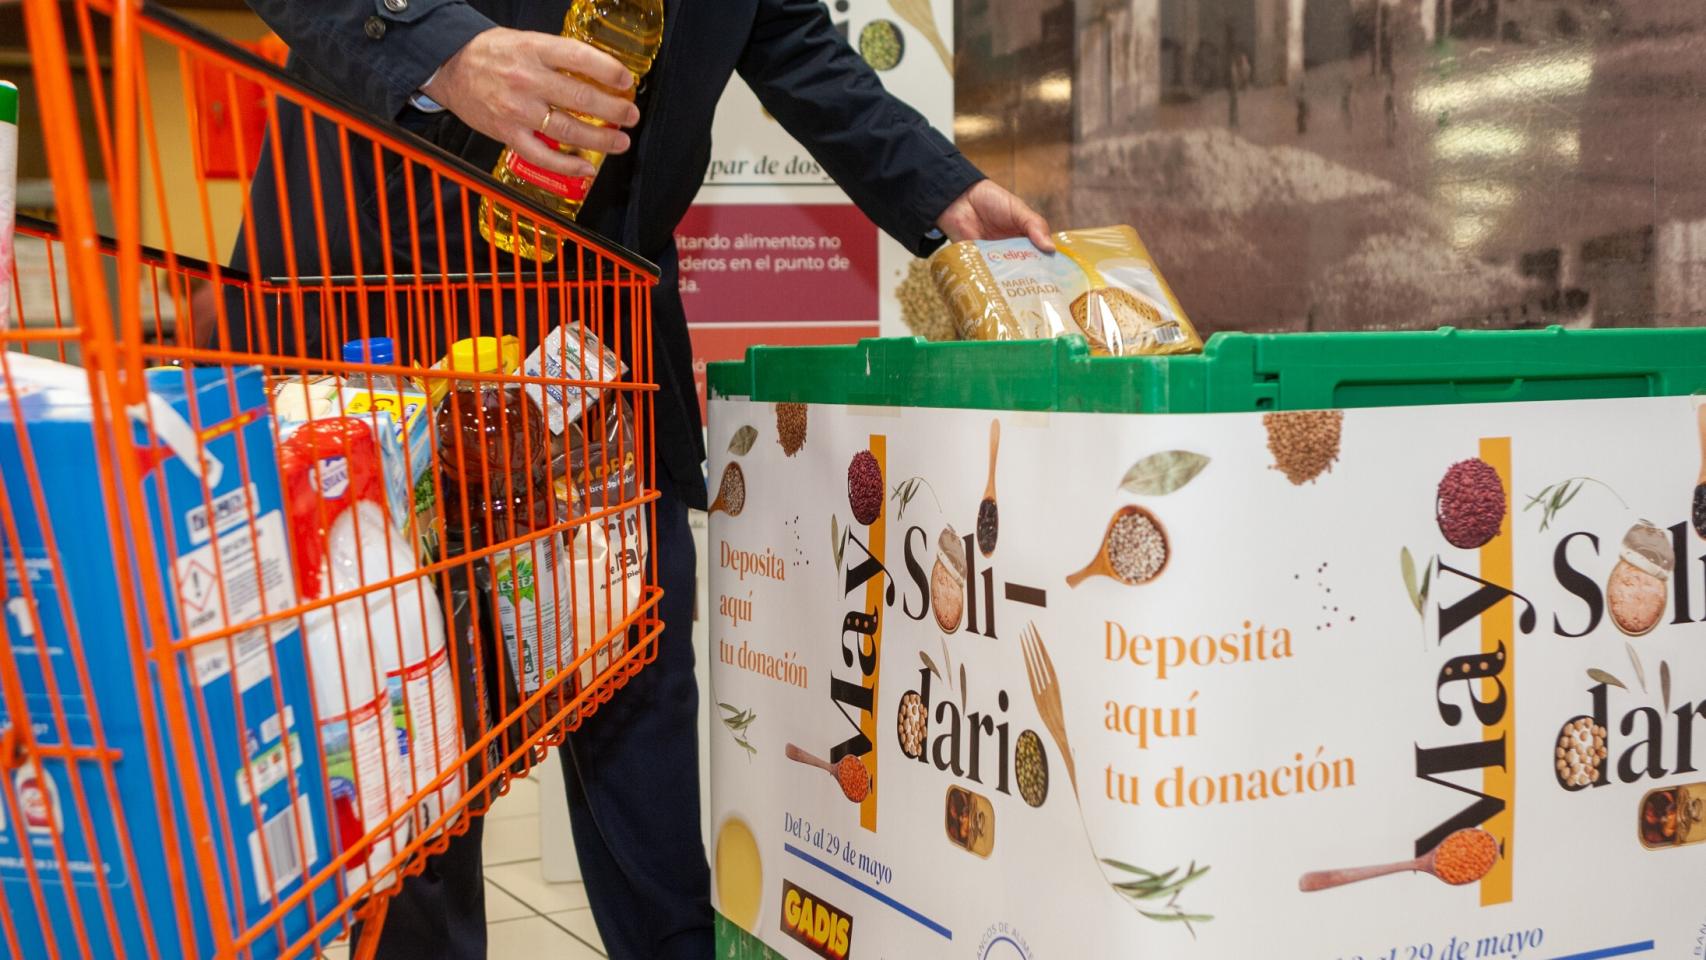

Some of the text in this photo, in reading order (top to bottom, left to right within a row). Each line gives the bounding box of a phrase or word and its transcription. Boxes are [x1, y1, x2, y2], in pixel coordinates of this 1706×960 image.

[709, 155, 821, 181] par de dos
[730, 258, 751, 271] en
[755, 255, 769, 271] el
[774, 255, 824, 273] punto
[828, 254, 849, 271] de
[735, 233, 815, 249] alimentos
[819, 236, 841, 249] no
[720, 540, 785, 582] Deposita
[1553, 483, 1706, 637] Sol
[719, 590, 753, 627] aquí
[719, 638, 808, 689] tu donación
[1103, 619, 1294, 680] Deposita
[1103, 690, 1200, 750] aquí
[1103, 745, 1356, 809] tu donación
[785, 811, 893, 886] Del 3 al 29 de mayo
[784, 888, 850, 959] GADIS
[1440, 935, 1470, 960] de
[1475, 927, 1544, 960] mayo
